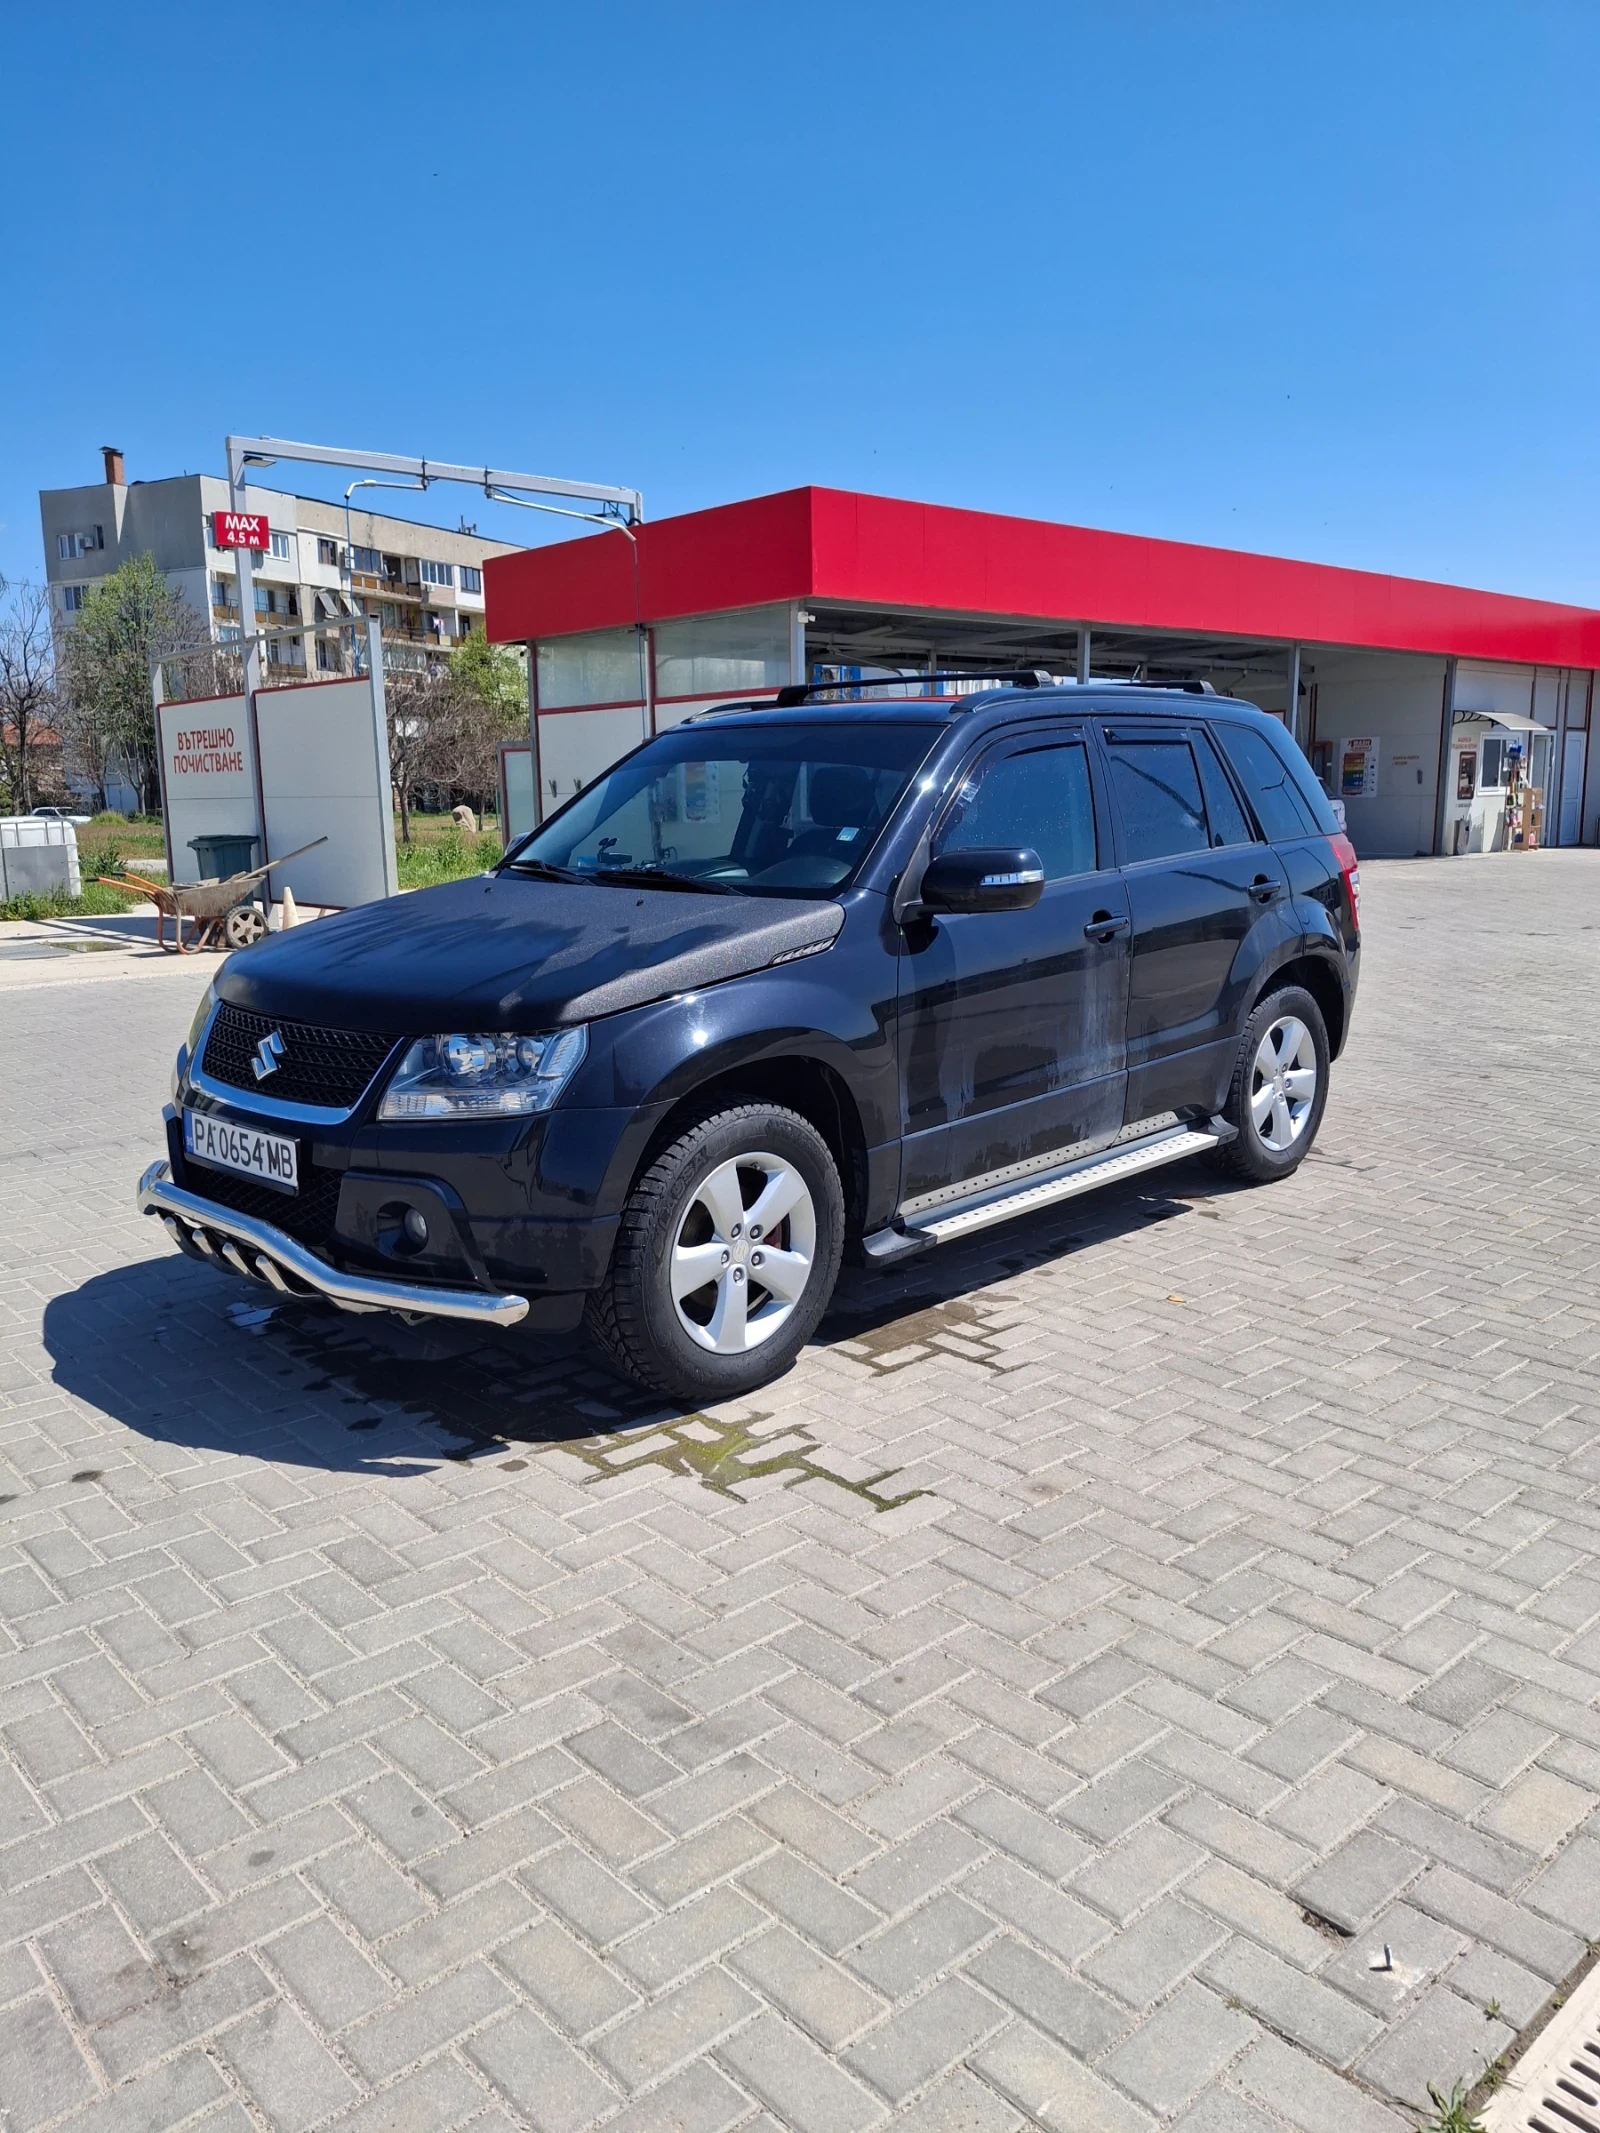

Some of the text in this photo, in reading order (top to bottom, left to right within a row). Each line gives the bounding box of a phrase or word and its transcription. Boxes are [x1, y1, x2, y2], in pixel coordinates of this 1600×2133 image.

[225, 515, 260, 532] MAX
[227, 531, 246, 543] 4.5
[177, 727, 234, 751] ВЪТРЕШНО
[173, 751, 243, 774] ПОЧИСТВАНЕ
